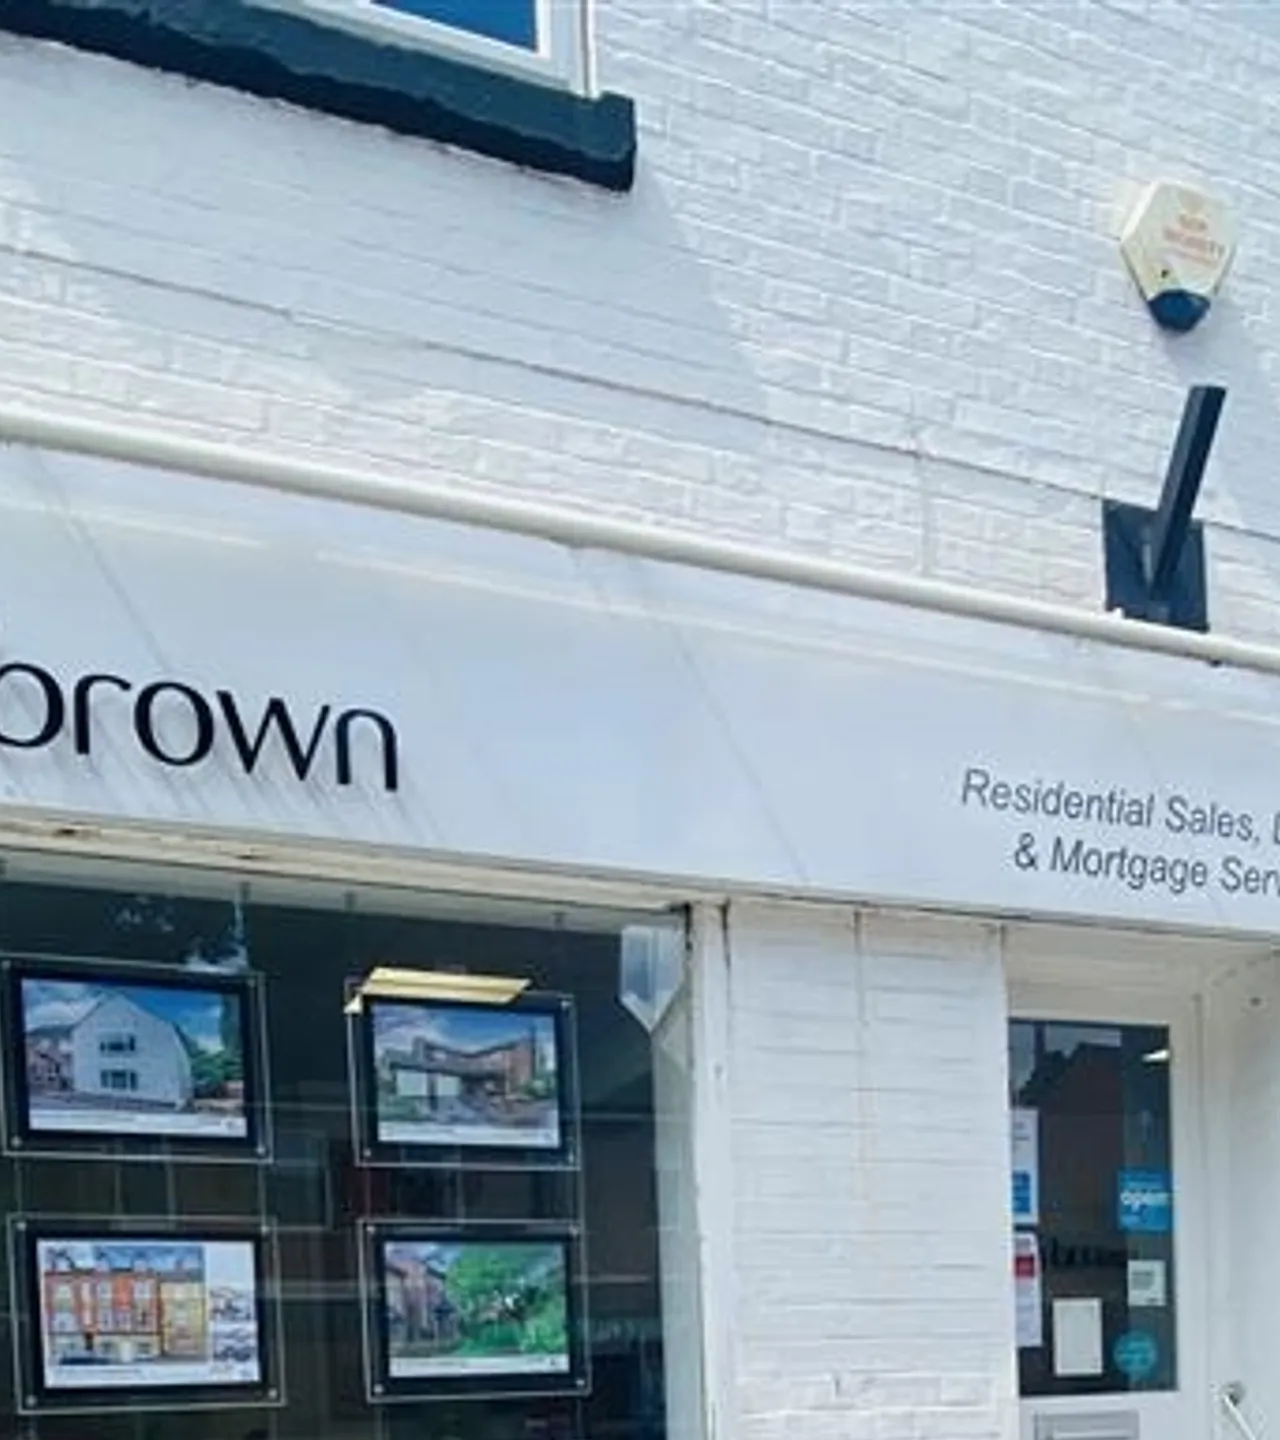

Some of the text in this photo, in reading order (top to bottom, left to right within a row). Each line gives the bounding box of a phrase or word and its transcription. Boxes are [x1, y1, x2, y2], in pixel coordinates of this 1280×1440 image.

[961, 768, 1155, 828] Residential
[1164, 794, 1261, 844] Sales,
[1013, 832, 1039, 872] &
[1049, 835, 1208, 894] Mortgage
